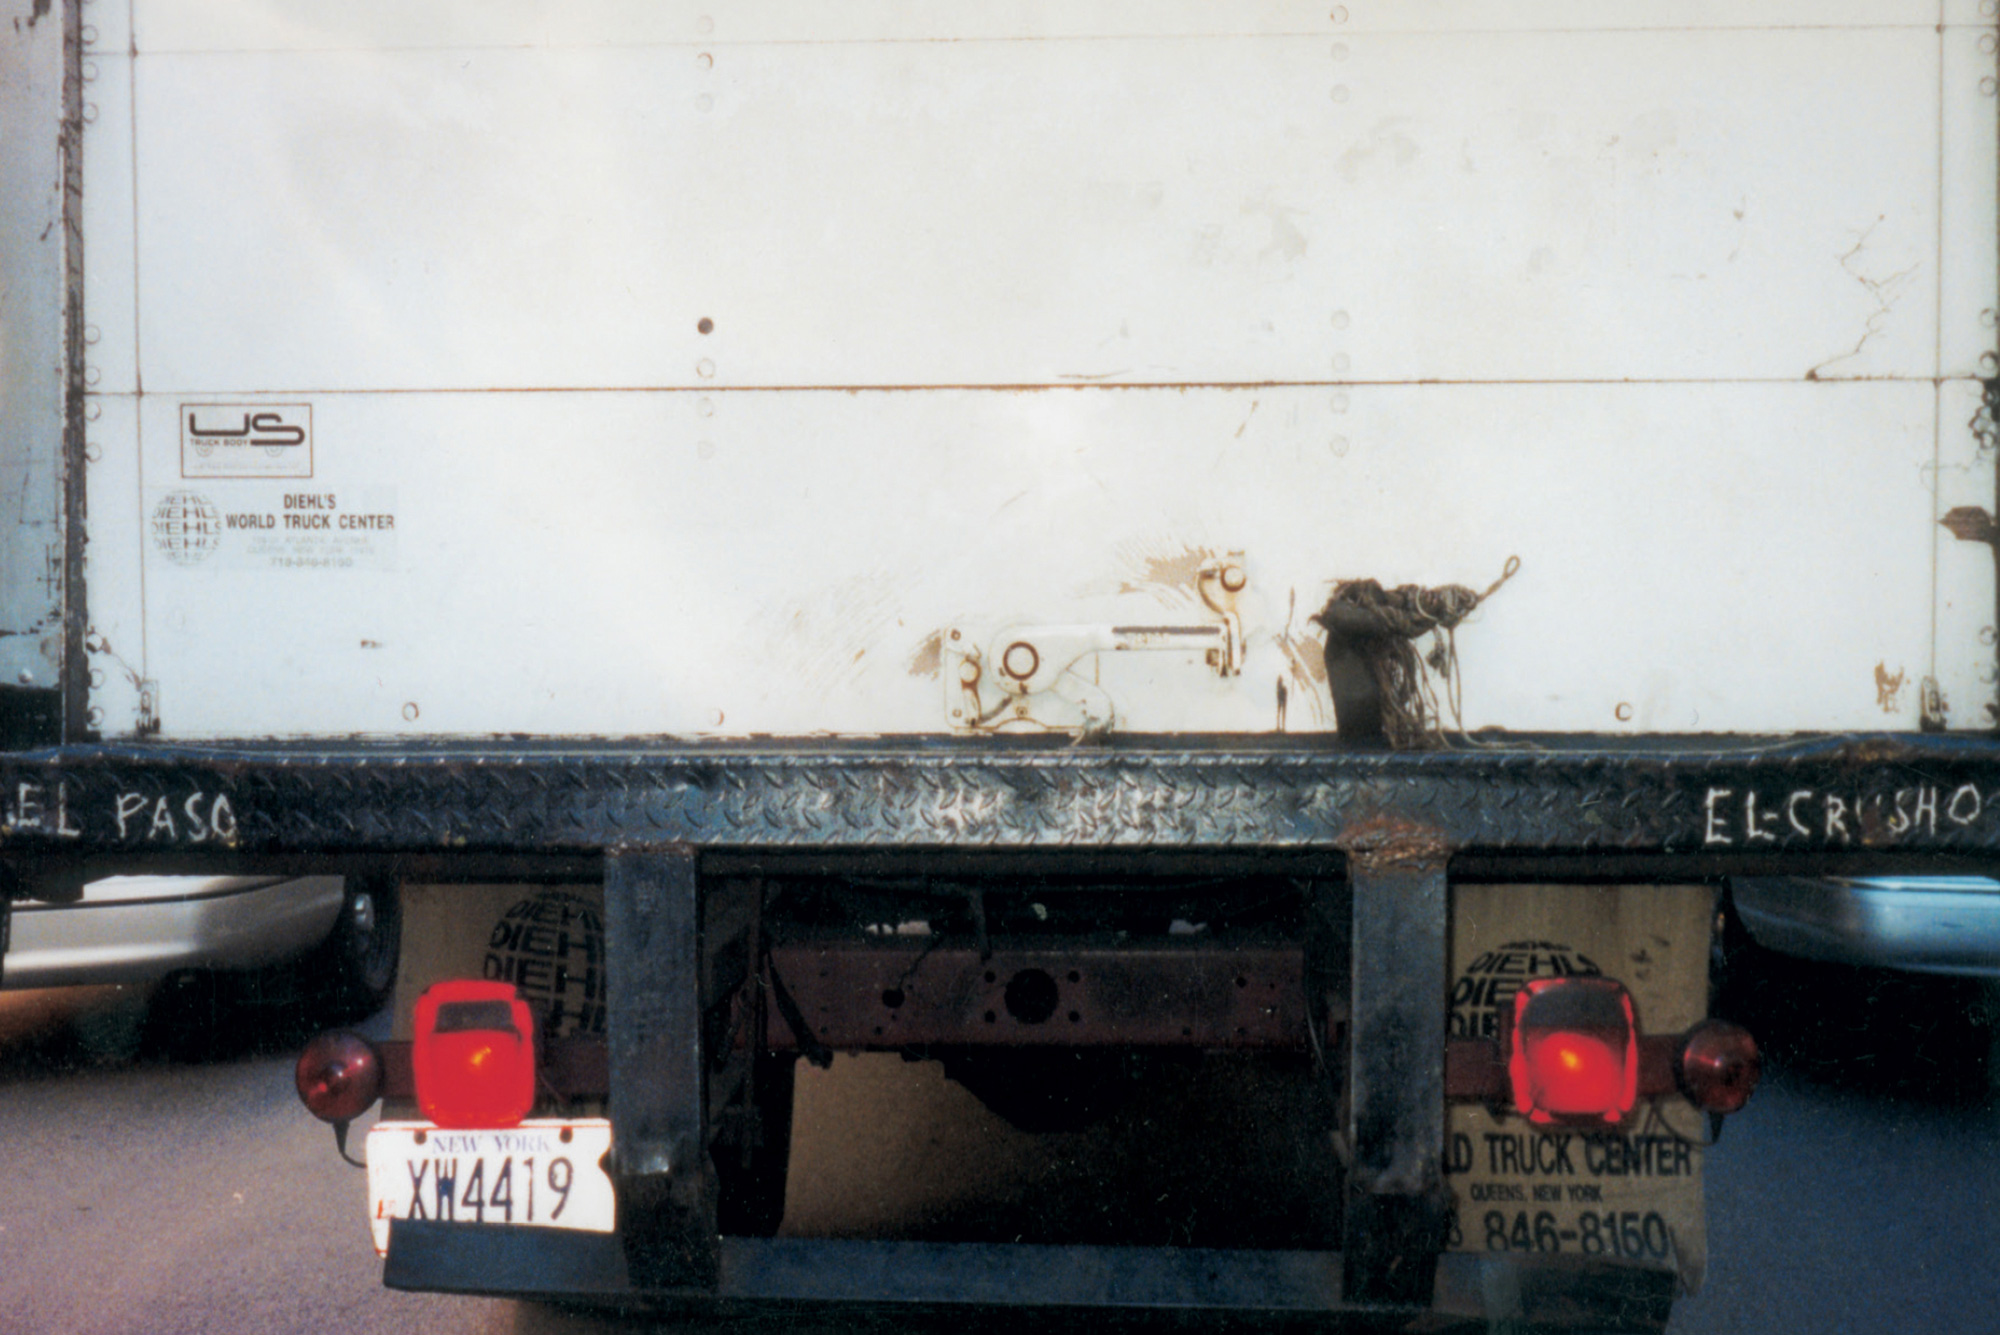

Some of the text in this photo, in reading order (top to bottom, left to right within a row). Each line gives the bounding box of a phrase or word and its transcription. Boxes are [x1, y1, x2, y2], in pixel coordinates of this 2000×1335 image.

[190, 438, 248, 447] TRUCK BODY
[283, 493, 336, 510] DIEHL'S
[226, 514, 395, 530] WORLD TRUCK CENTER
[18, 782, 239, 843] EL PASO
[432, 1134, 551, 1154] NEW YORK
[1484, 1133, 1575, 1176] TRUCK
[1583, 1134, 1692, 1177] CENTER
[1532, 1184, 1562, 1203] NEW
[1567, 1184, 1604, 1203] YORK
